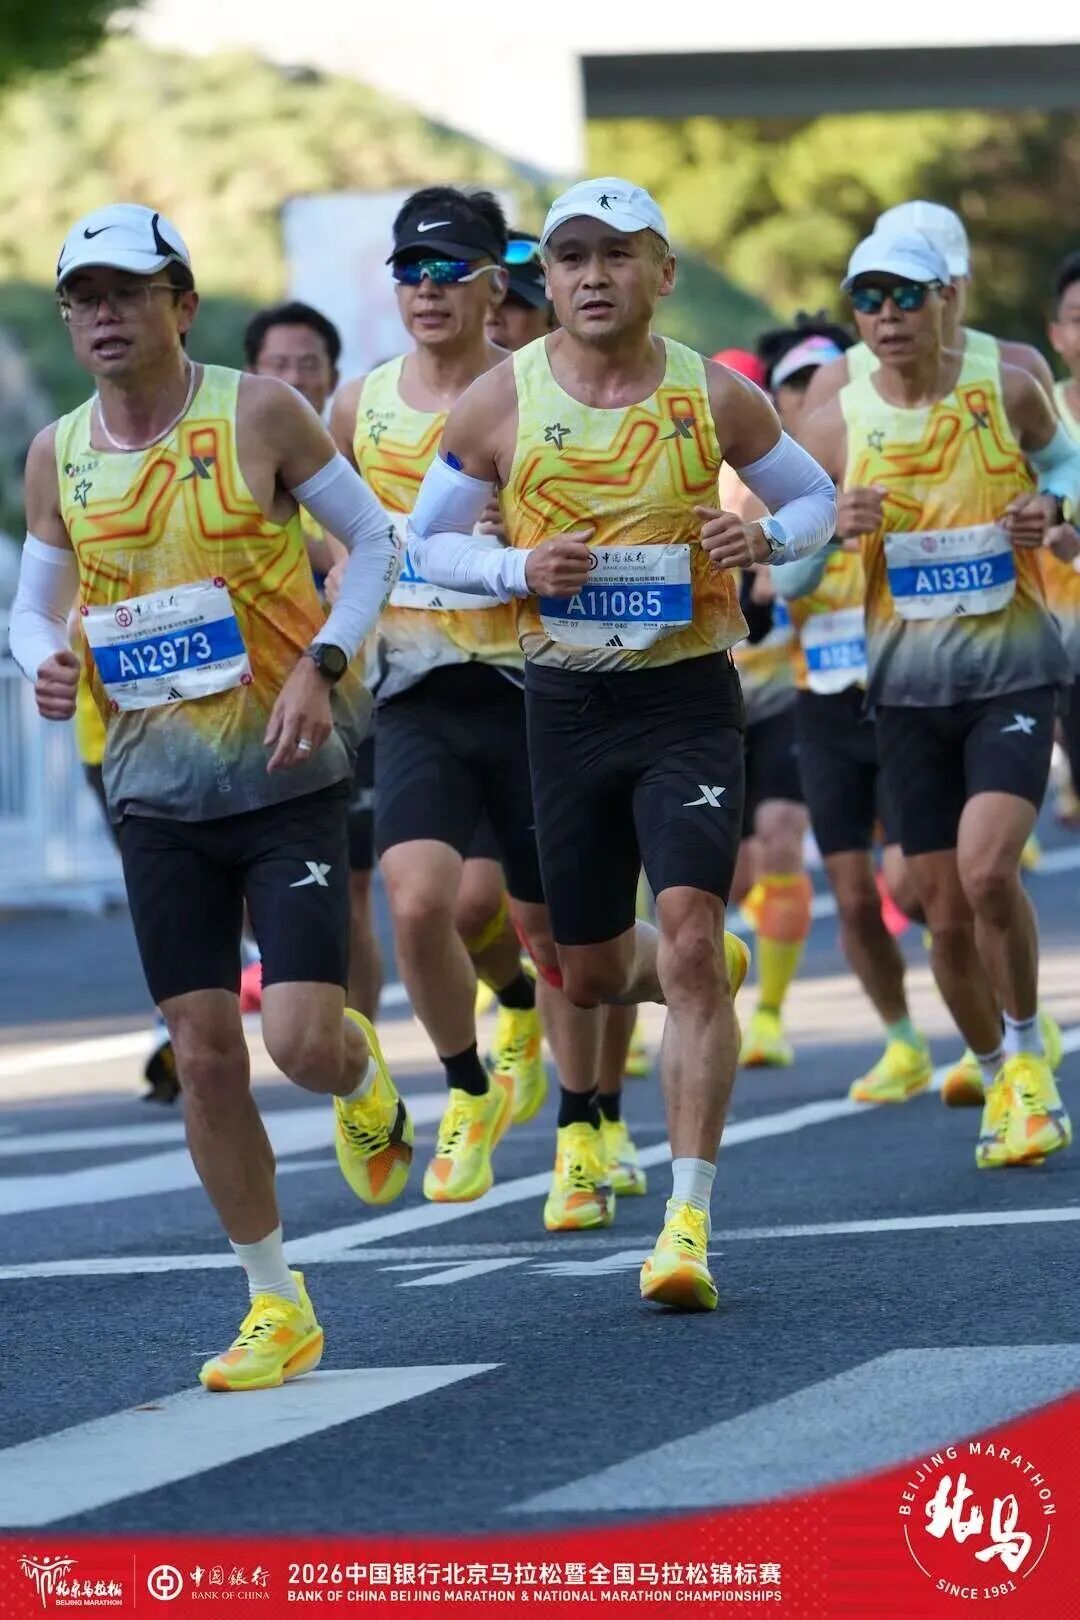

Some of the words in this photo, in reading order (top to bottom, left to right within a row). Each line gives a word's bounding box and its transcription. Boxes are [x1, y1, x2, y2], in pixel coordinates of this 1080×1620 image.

[916, 562, 994, 593] A13312
[567, 591, 662, 617] A11085
[119, 632, 212, 677] A12973
